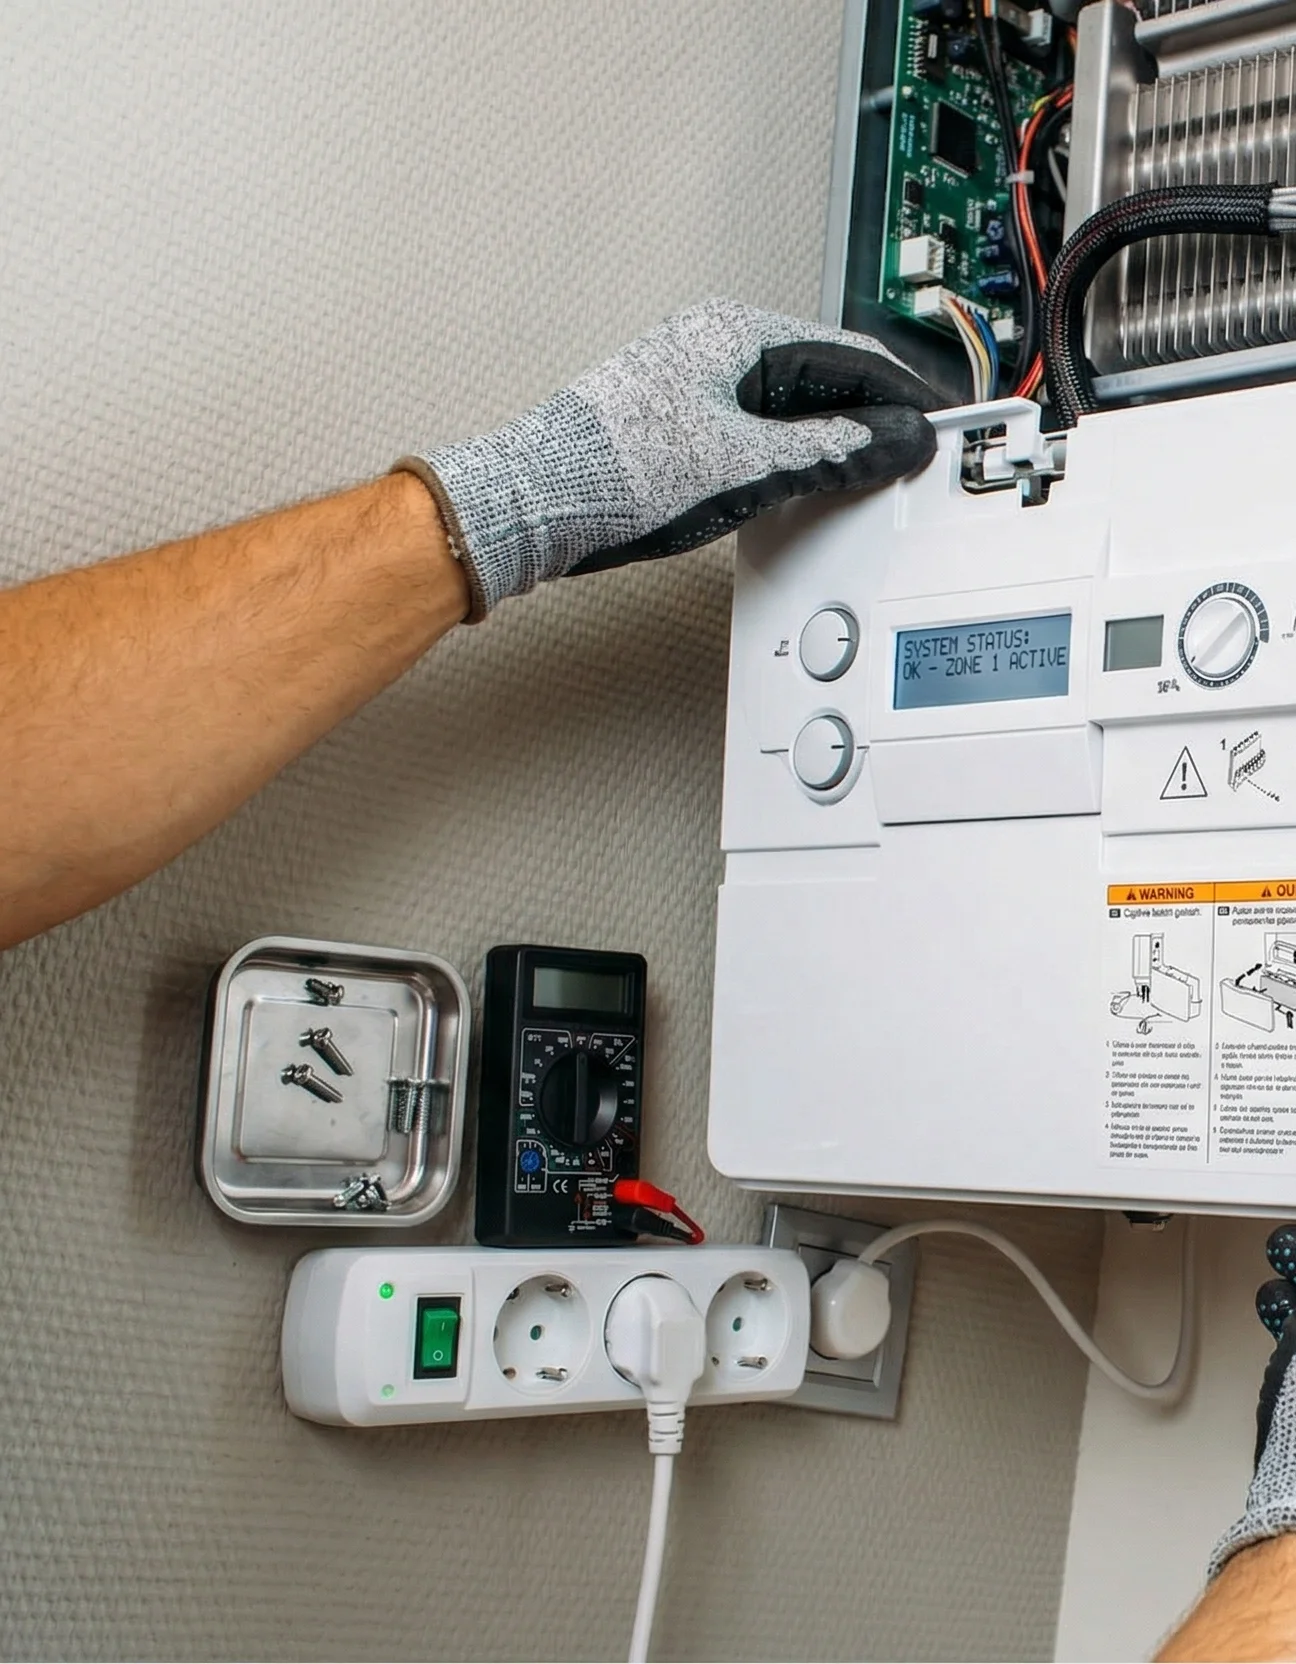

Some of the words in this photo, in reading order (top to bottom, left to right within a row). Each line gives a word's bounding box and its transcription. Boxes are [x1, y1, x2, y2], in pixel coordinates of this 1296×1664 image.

[904, 635, 959, 659] SYSTEM
[967, 629, 1030, 653] STATUS:
[903, 661, 922, 680] OK
[945, 655, 982, 677] ZONE
[992, 655, 998, 672] 1
[1009, 646, 1067, 670] ACTIVE
[1220, 738, 1227, 751] 1
[1139, 887, 1195, 901] WARNING
